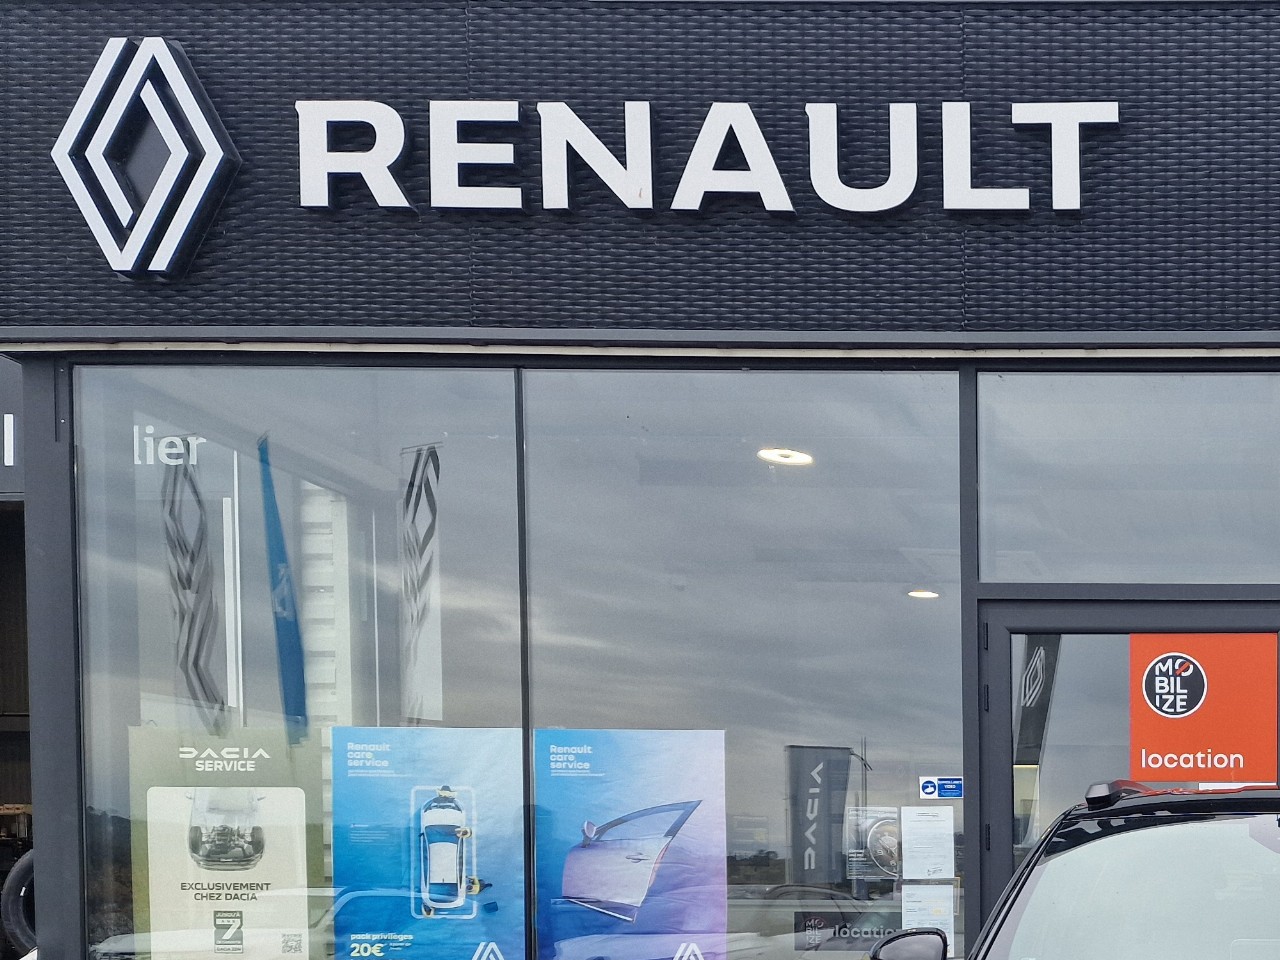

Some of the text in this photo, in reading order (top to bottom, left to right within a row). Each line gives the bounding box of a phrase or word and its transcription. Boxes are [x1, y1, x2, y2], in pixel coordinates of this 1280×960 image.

[295, 100, 1119, 212] RENAULT
[347, 743, 391, 751] Renault
[550, 745, 593, 754] Renault
[179, 747, 271, 759] DACIA
[1141, 748, 1244, 768] location
[195, 760, 256, 772] SERVICE
[347, 758, 389, 767] service
[550, 761, 591, 769] service
[180, 882, 271, 891] EXCLUSIVEMENT
[194, 892, 258, 901] CHEZ DACIA
[835, 924, 900, 938] locatio
[350, 943, 385, 957] 20€
